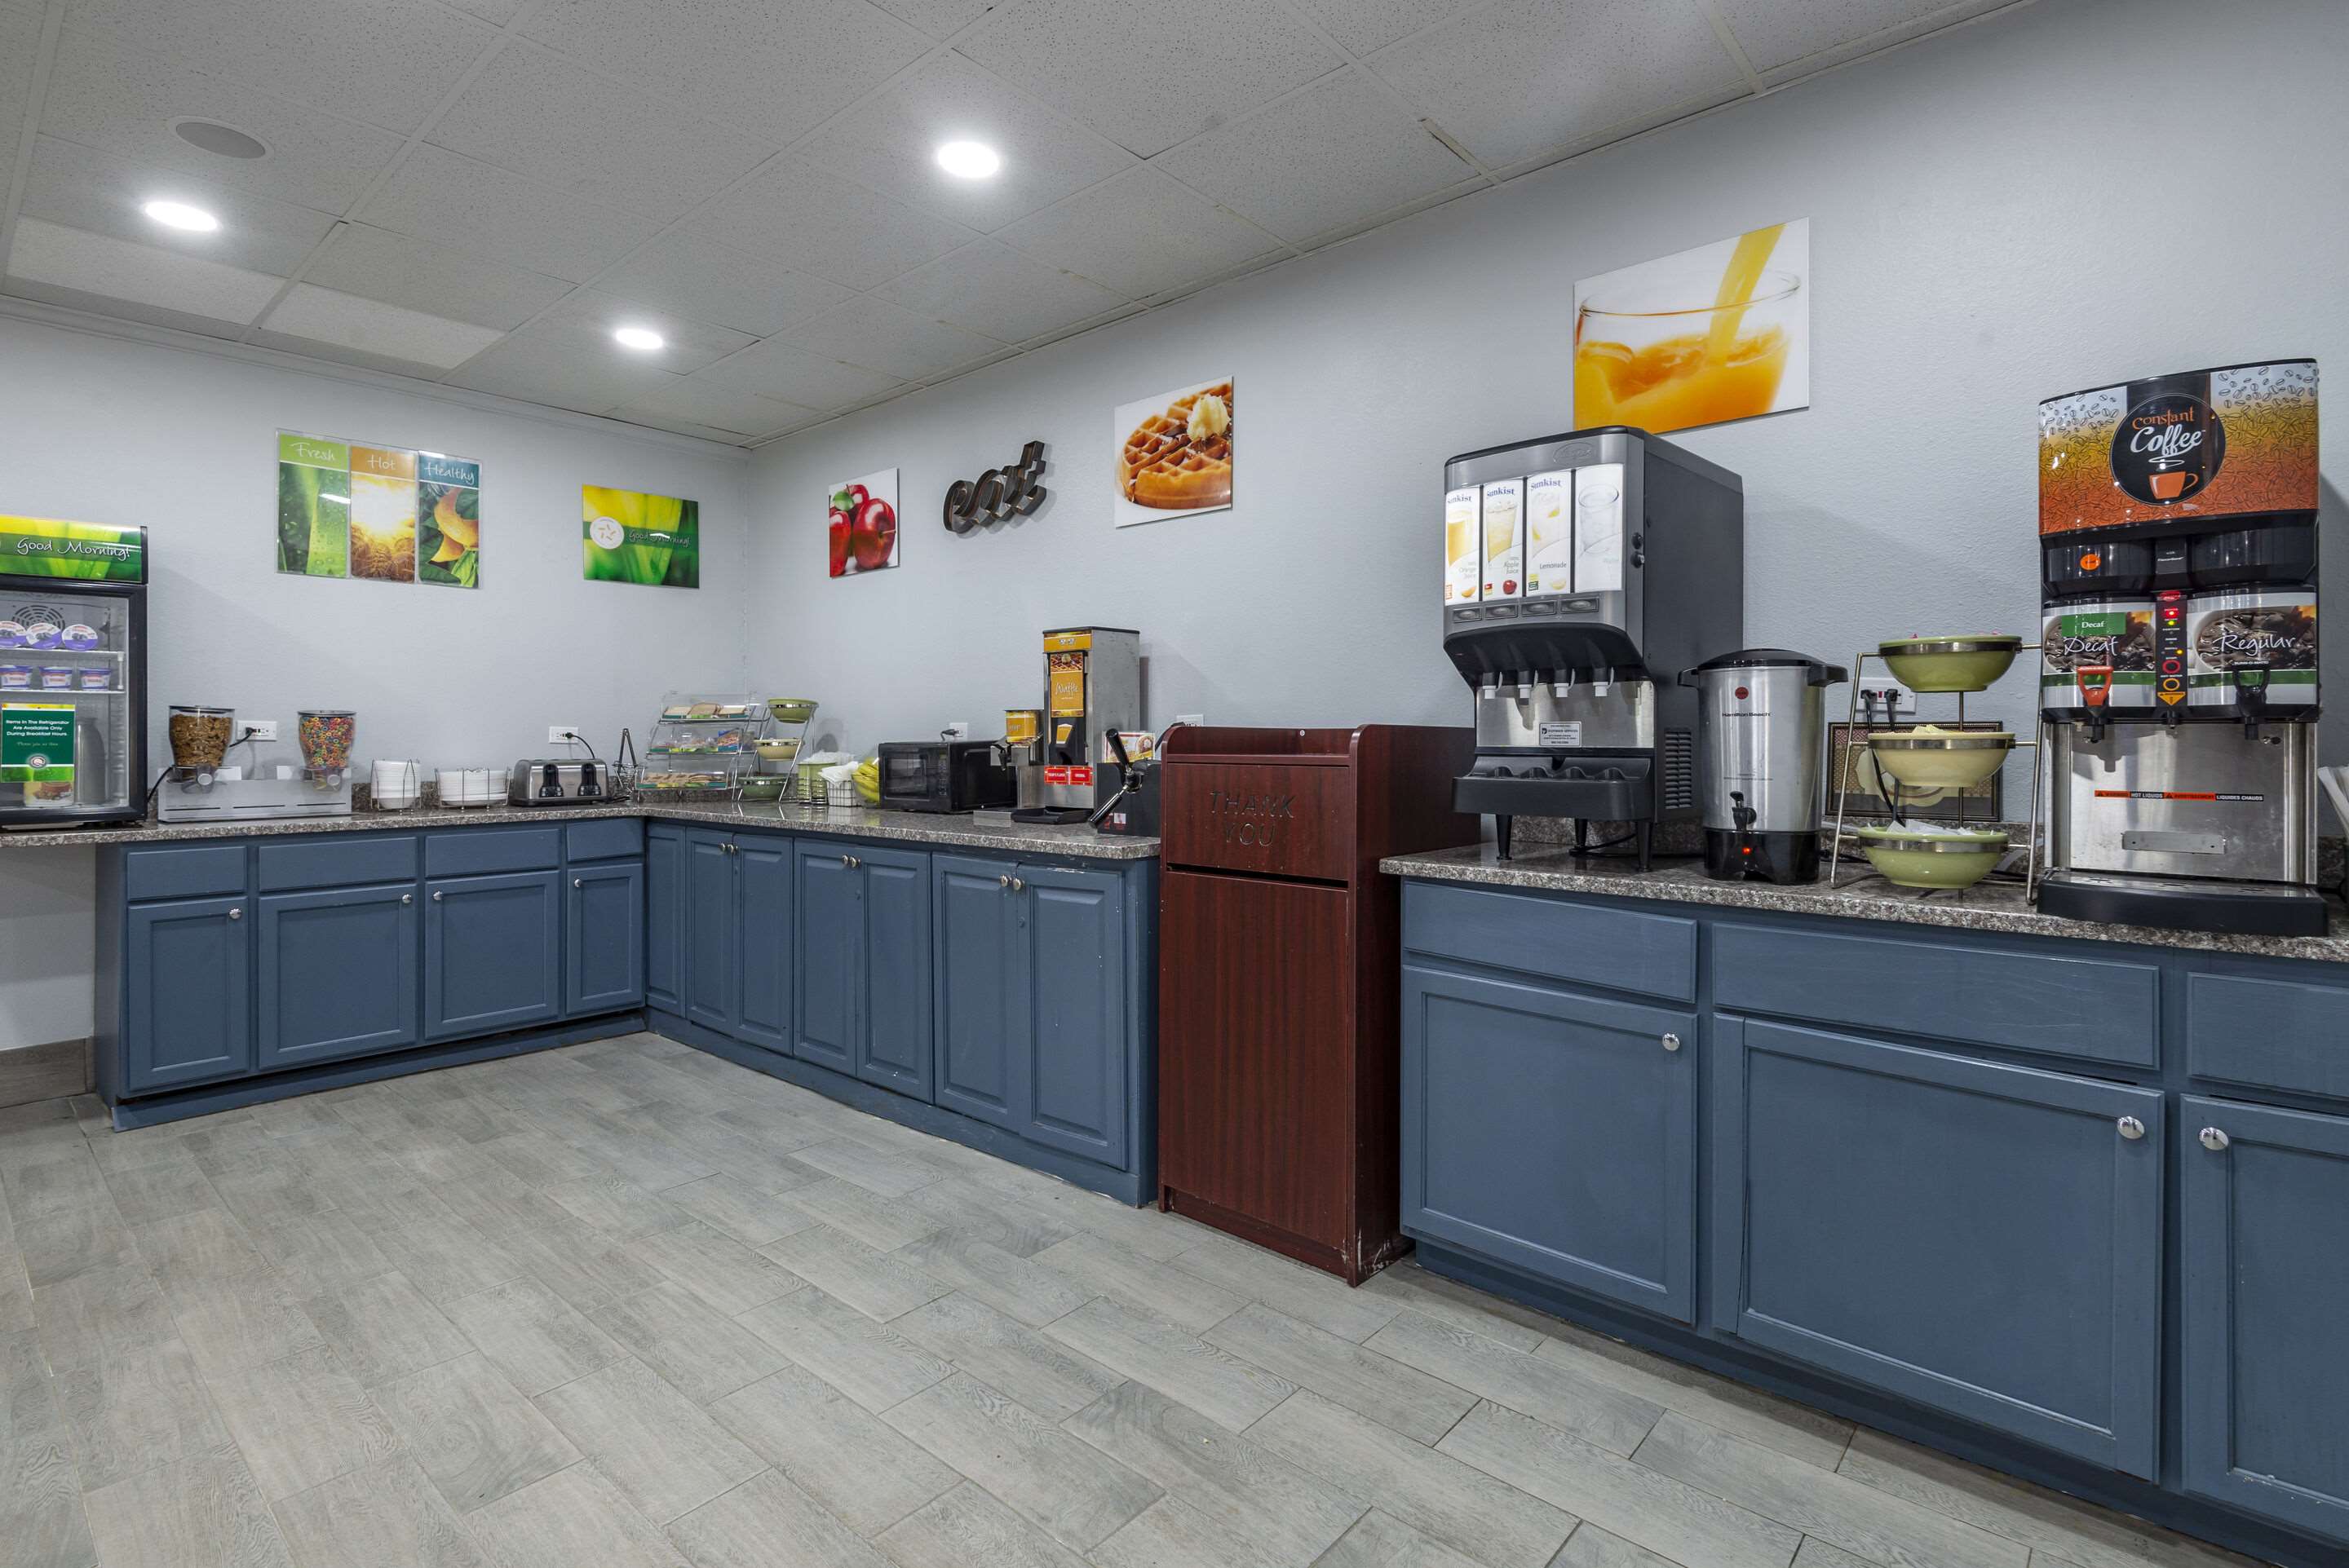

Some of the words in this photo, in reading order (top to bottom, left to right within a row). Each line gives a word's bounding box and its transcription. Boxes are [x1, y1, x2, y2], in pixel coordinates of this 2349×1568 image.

[2130, 424, 2204, 457] Coffee
[290, 442, 336, 462] Fresh
[367, 454, 396, 470] Hot
[423, 462, 476, 484] Healthy
[629, 529, 650, 542] Good
[16, 537, 52, 555] Good
[57, 541, 130, 561] Morning!
[1539, 561, 1567, 569] Lemonade
[2081, 621, 2105, 629] Decaf
[2063, 635, 2119, 656] Decaf
[2212, 634, 2297, 656] Regular
[1210, 790, 1297, 819] THANK
[1225, 822, 1276, 847] YOU
